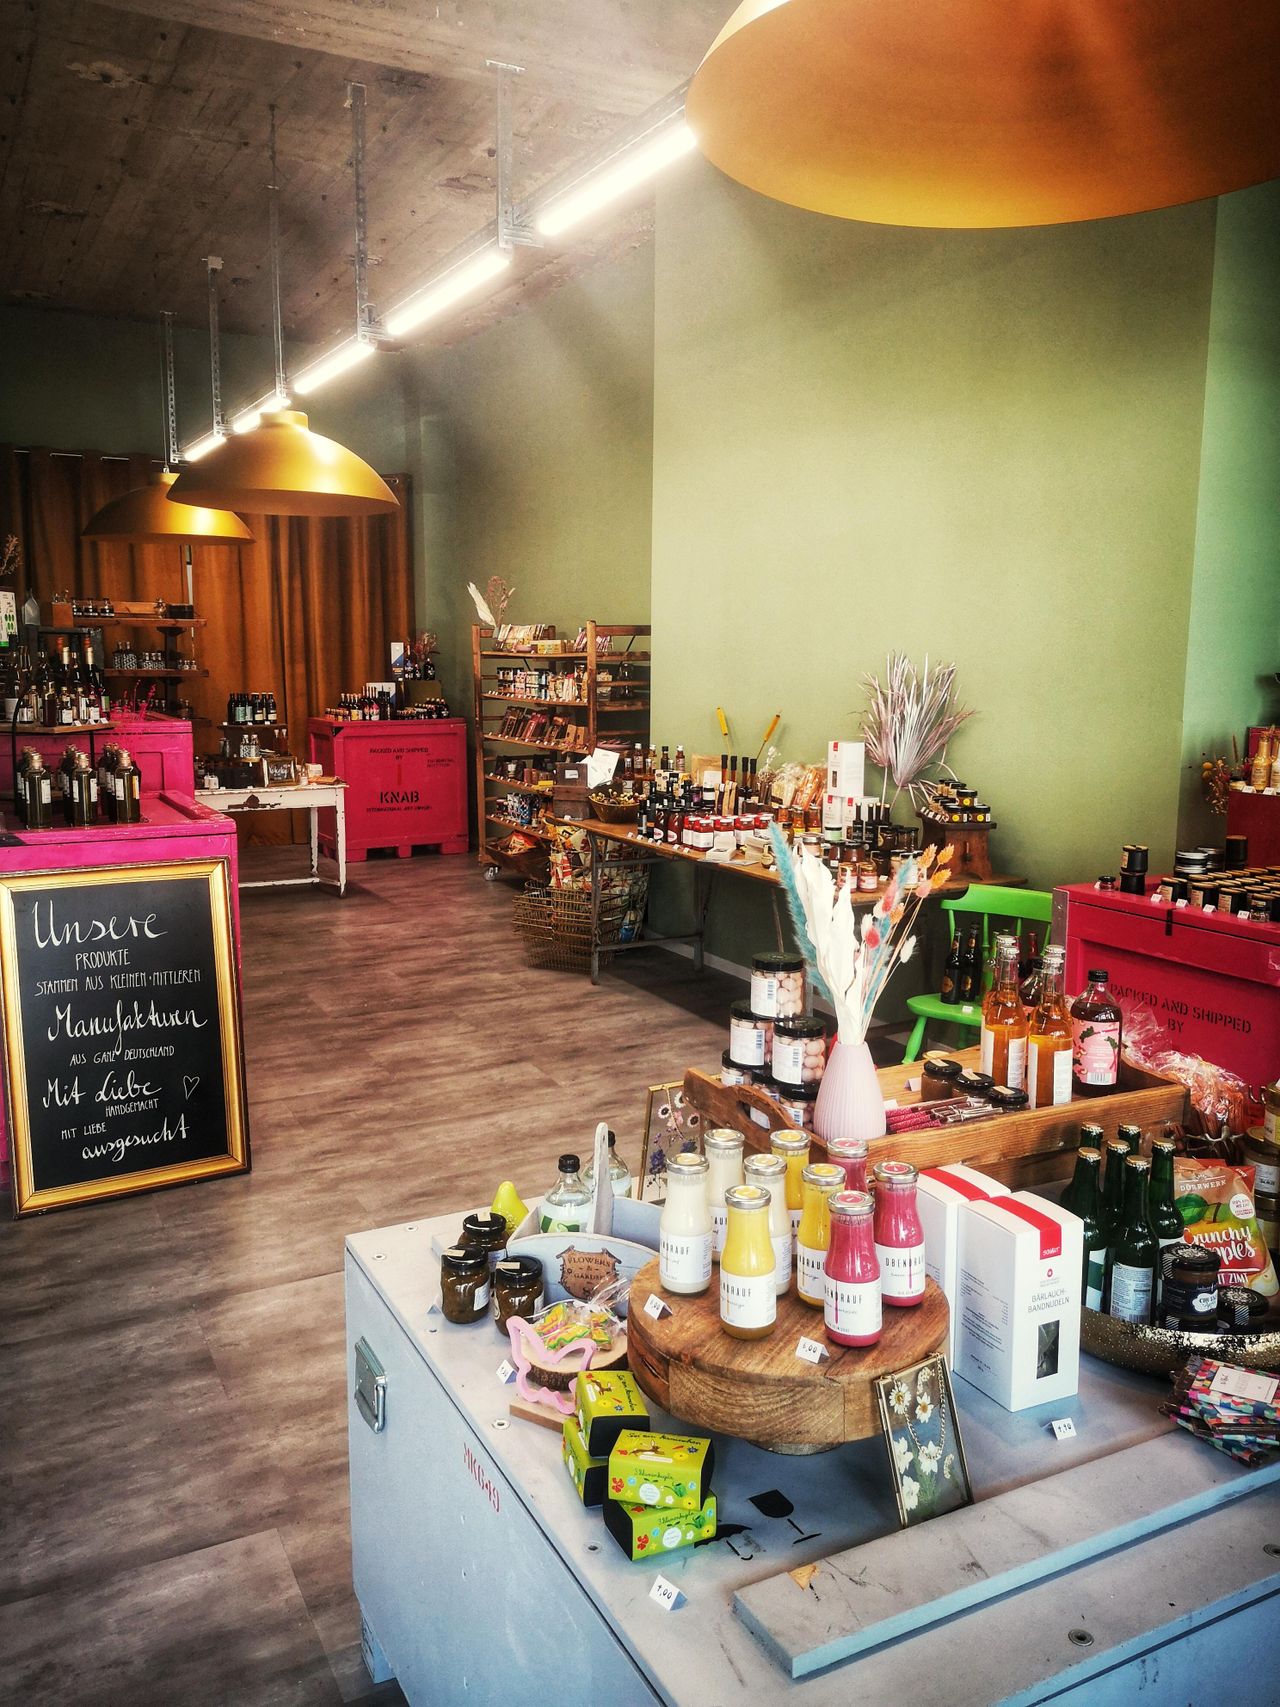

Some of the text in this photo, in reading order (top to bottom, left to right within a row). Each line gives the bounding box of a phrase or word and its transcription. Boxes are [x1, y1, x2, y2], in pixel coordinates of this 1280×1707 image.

[380, 791, 419, 803] KNAB
[32, 900, 168, 948] Unsere
[75, 949, 130, 971] PRODUKTE
[34, 969, 200, 996] STAMMEN AUS KLEINEN MITTLEREN
[1110, 983, 1252, 1034] PACKED AND SHIPPED
[47, 1000, 208, 1055] Manufakturen
[1167, 1018, 1184, 1033] BY
[70, 1045, 174, 1067] AUS GANZ DEUTSCHLAND
[42, 1070, 162, 1108] Mit Liebe
[105, 1098, 159, 1117] HANDGEMACHT
[61, 1122, 107, 1140] MIT LIEBE
[82, 1113, 190, 1162] ausgesucht
[1183, 1226, 1252, 1245] Crunchy
[1217, 1272, 1249, 1285] IT ZIMT
[1028, 1296, 1070, 1313] BANDNUDELN
